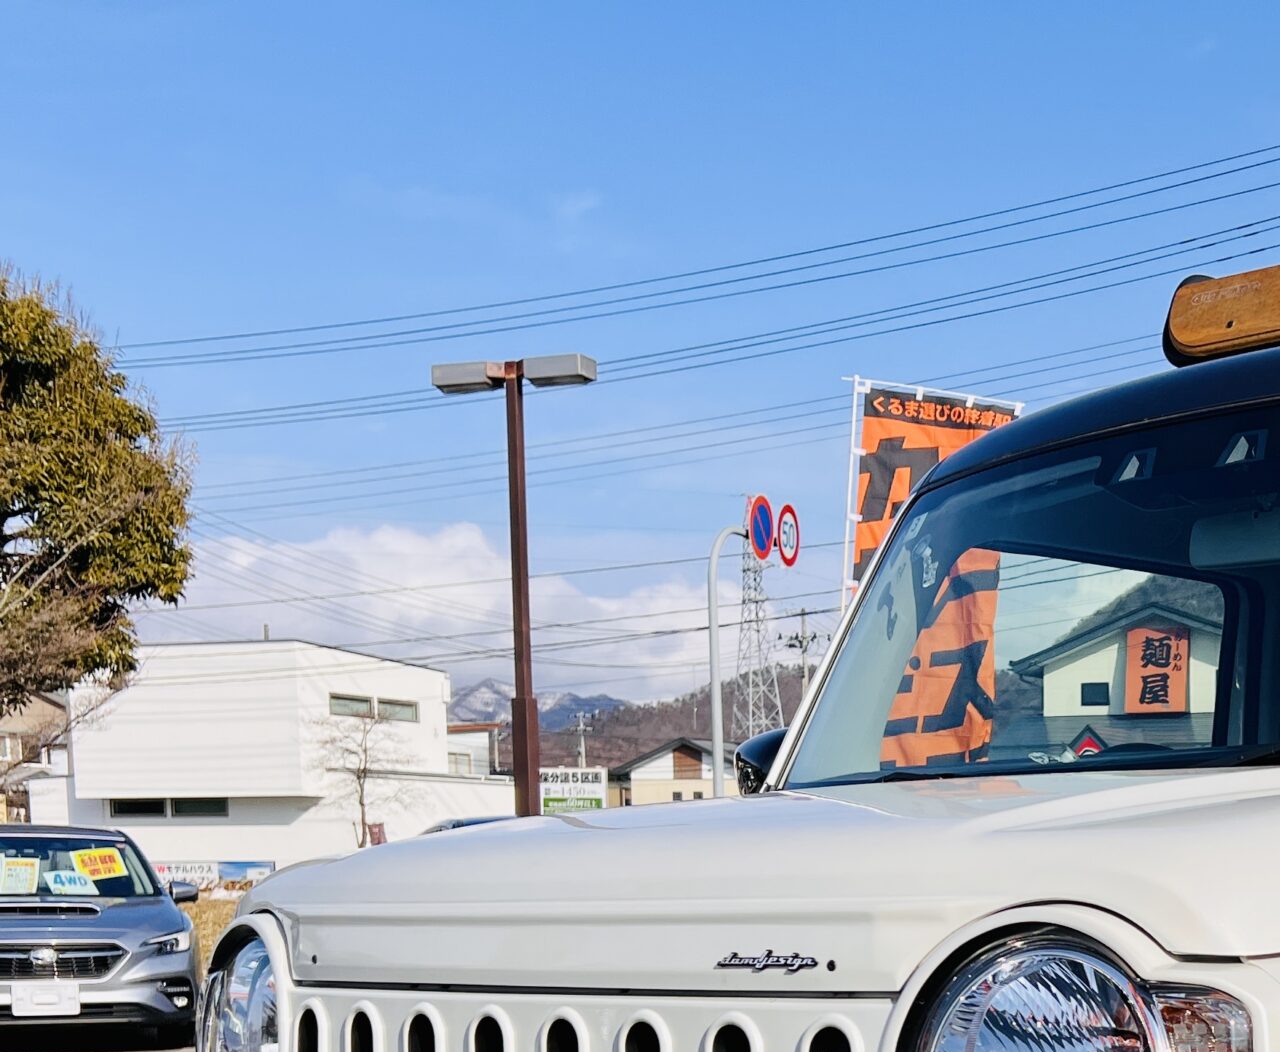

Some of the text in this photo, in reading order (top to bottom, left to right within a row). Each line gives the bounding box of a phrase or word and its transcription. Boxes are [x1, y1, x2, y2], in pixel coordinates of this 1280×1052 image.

[782, 520, 795, 550] 50
[1139, 635, 1172, 704] 麺屋
[53, 872, 87, 887] 4WD
